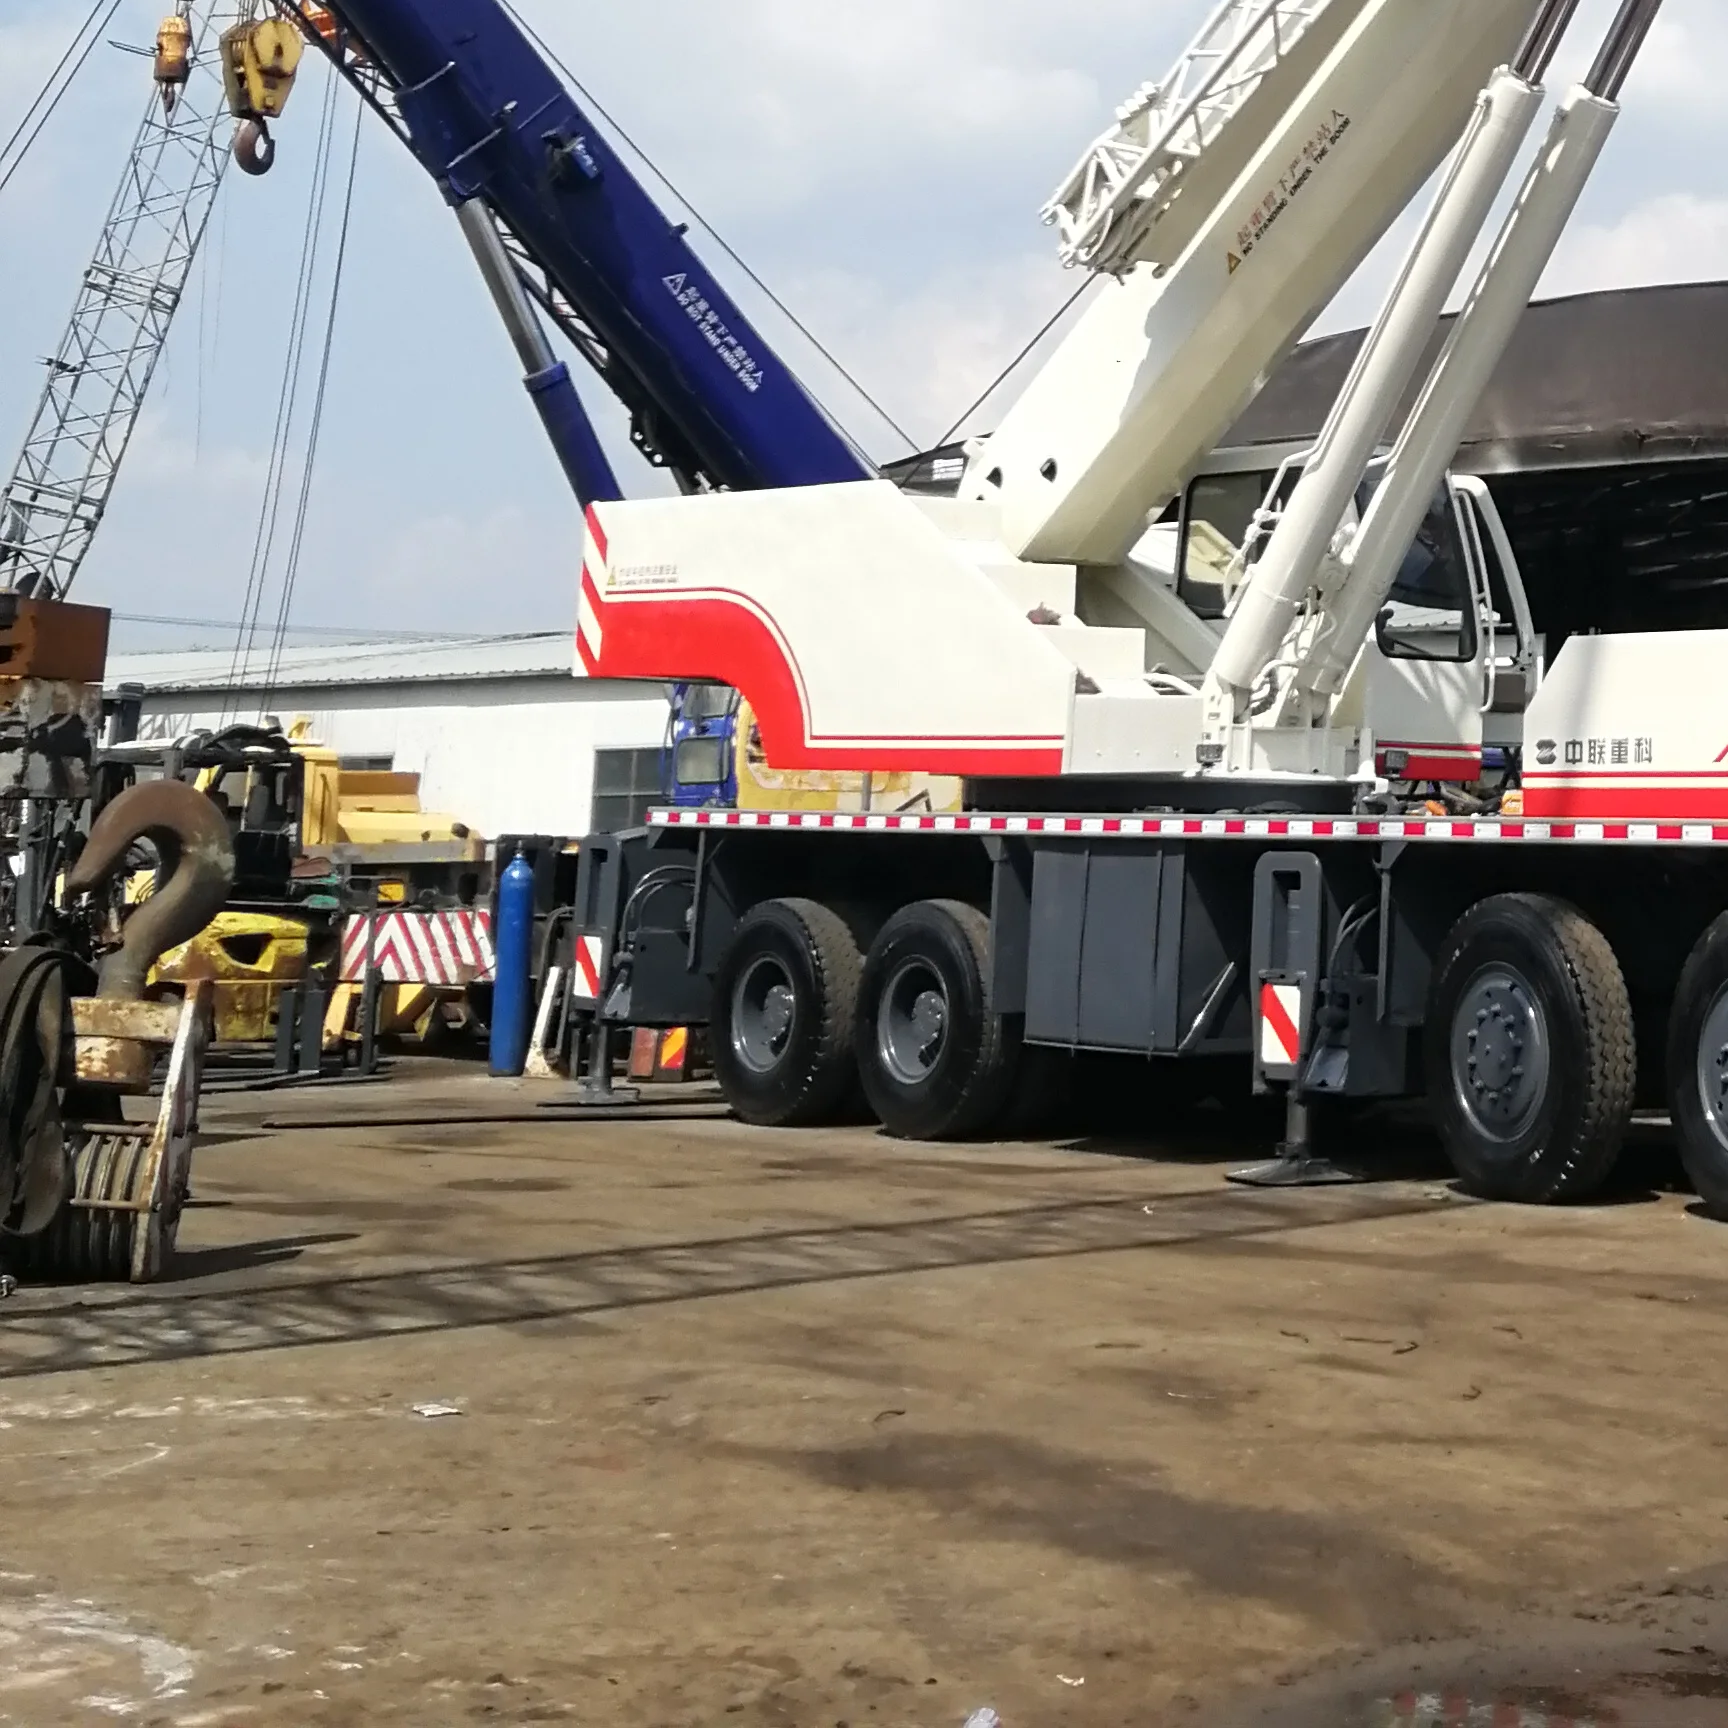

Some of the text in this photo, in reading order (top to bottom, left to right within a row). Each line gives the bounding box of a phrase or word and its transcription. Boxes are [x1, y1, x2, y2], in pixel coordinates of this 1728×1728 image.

[1255, 198, 1288, 240] STANDING
[1289, 167, 1313, 197] UNDER
[1314, 146, 1329, 164] THE
[1330, 118, 1350, 145] BOOM
[686, 304, 703, 322] NOT
[698, 321, 721, 348] STAND
[718, 345, 741, 371] UNDER
[737, 370, 759, 392] BOOM
[1565, 737, 1652, 764] 中联重科
